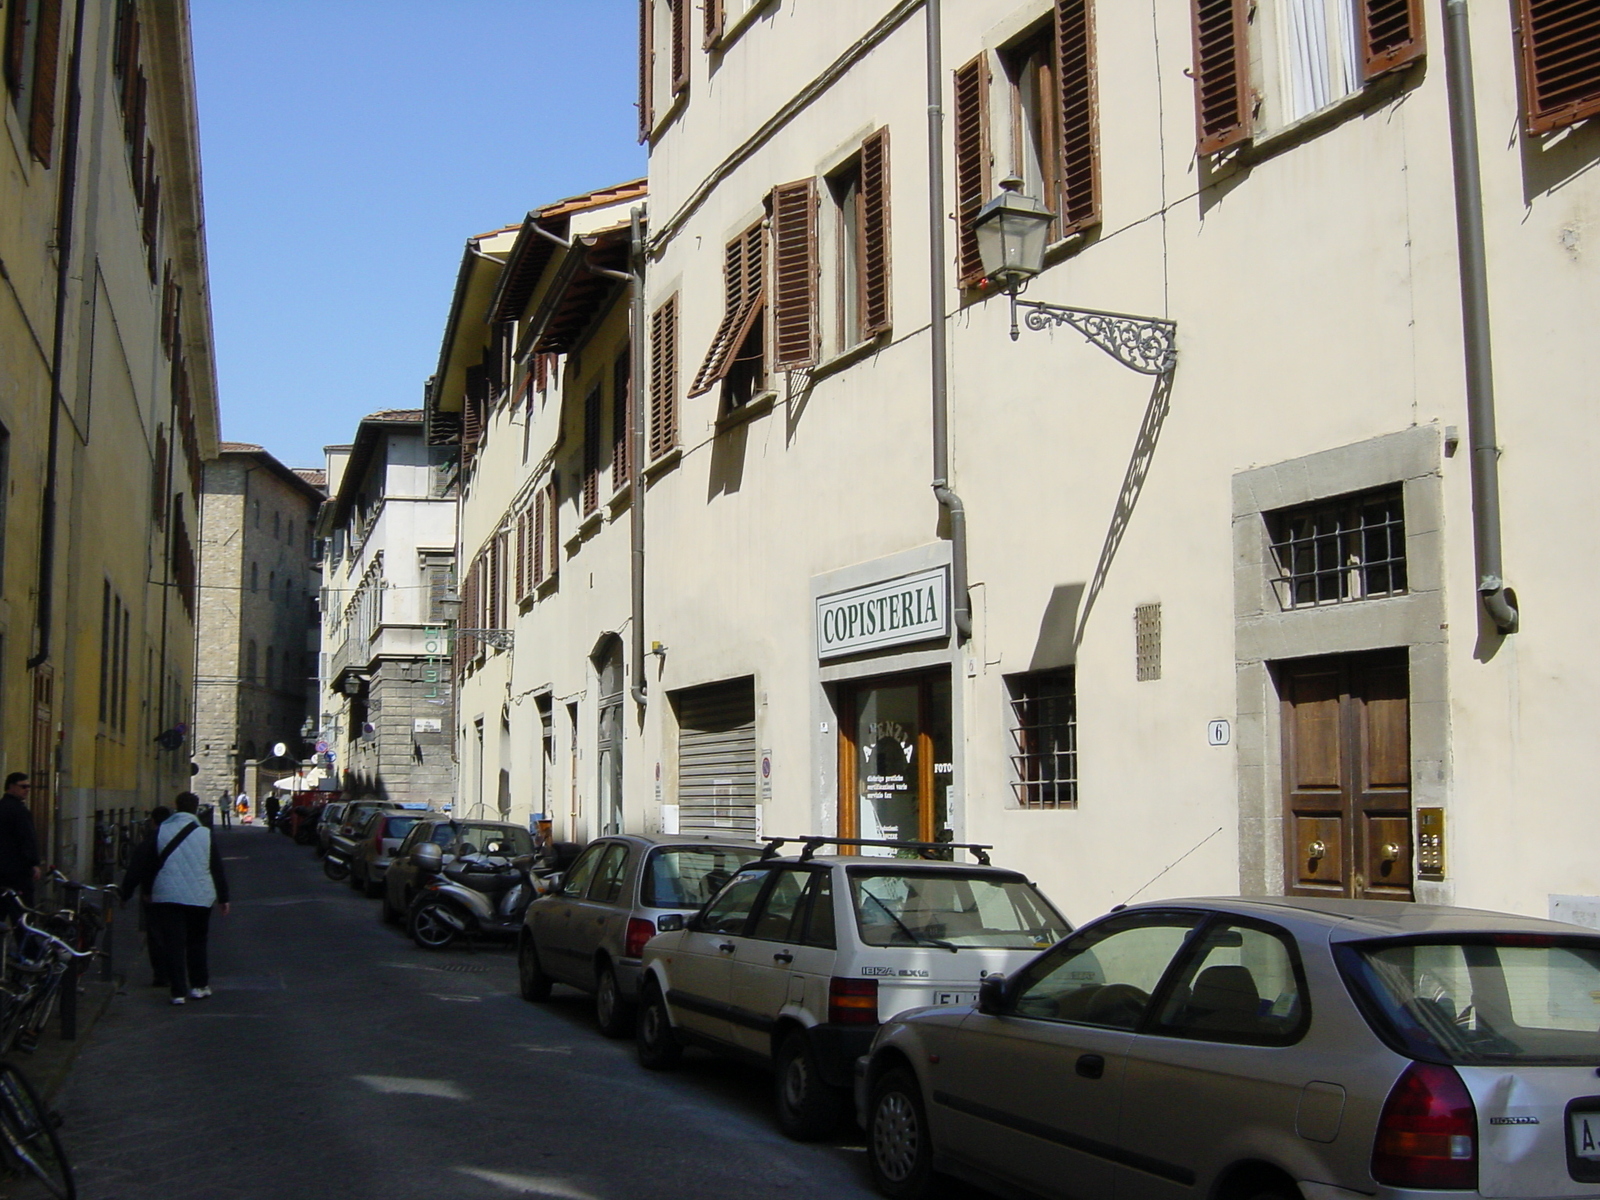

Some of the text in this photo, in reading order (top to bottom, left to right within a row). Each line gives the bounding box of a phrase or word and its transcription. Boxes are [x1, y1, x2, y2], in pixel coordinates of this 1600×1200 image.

[824, 585, 938, 644] COPISTERIA
[425, 626, 439, 698] HOTEL
[1215, 723, 1223, 742] 6
[934, 763, 953, 774] FOTO
[862, 967, 896, 977] IBIZA
[1490, 1117, 1540, 1125] HONDA
[1583, 1118, 1600, 1151] A
